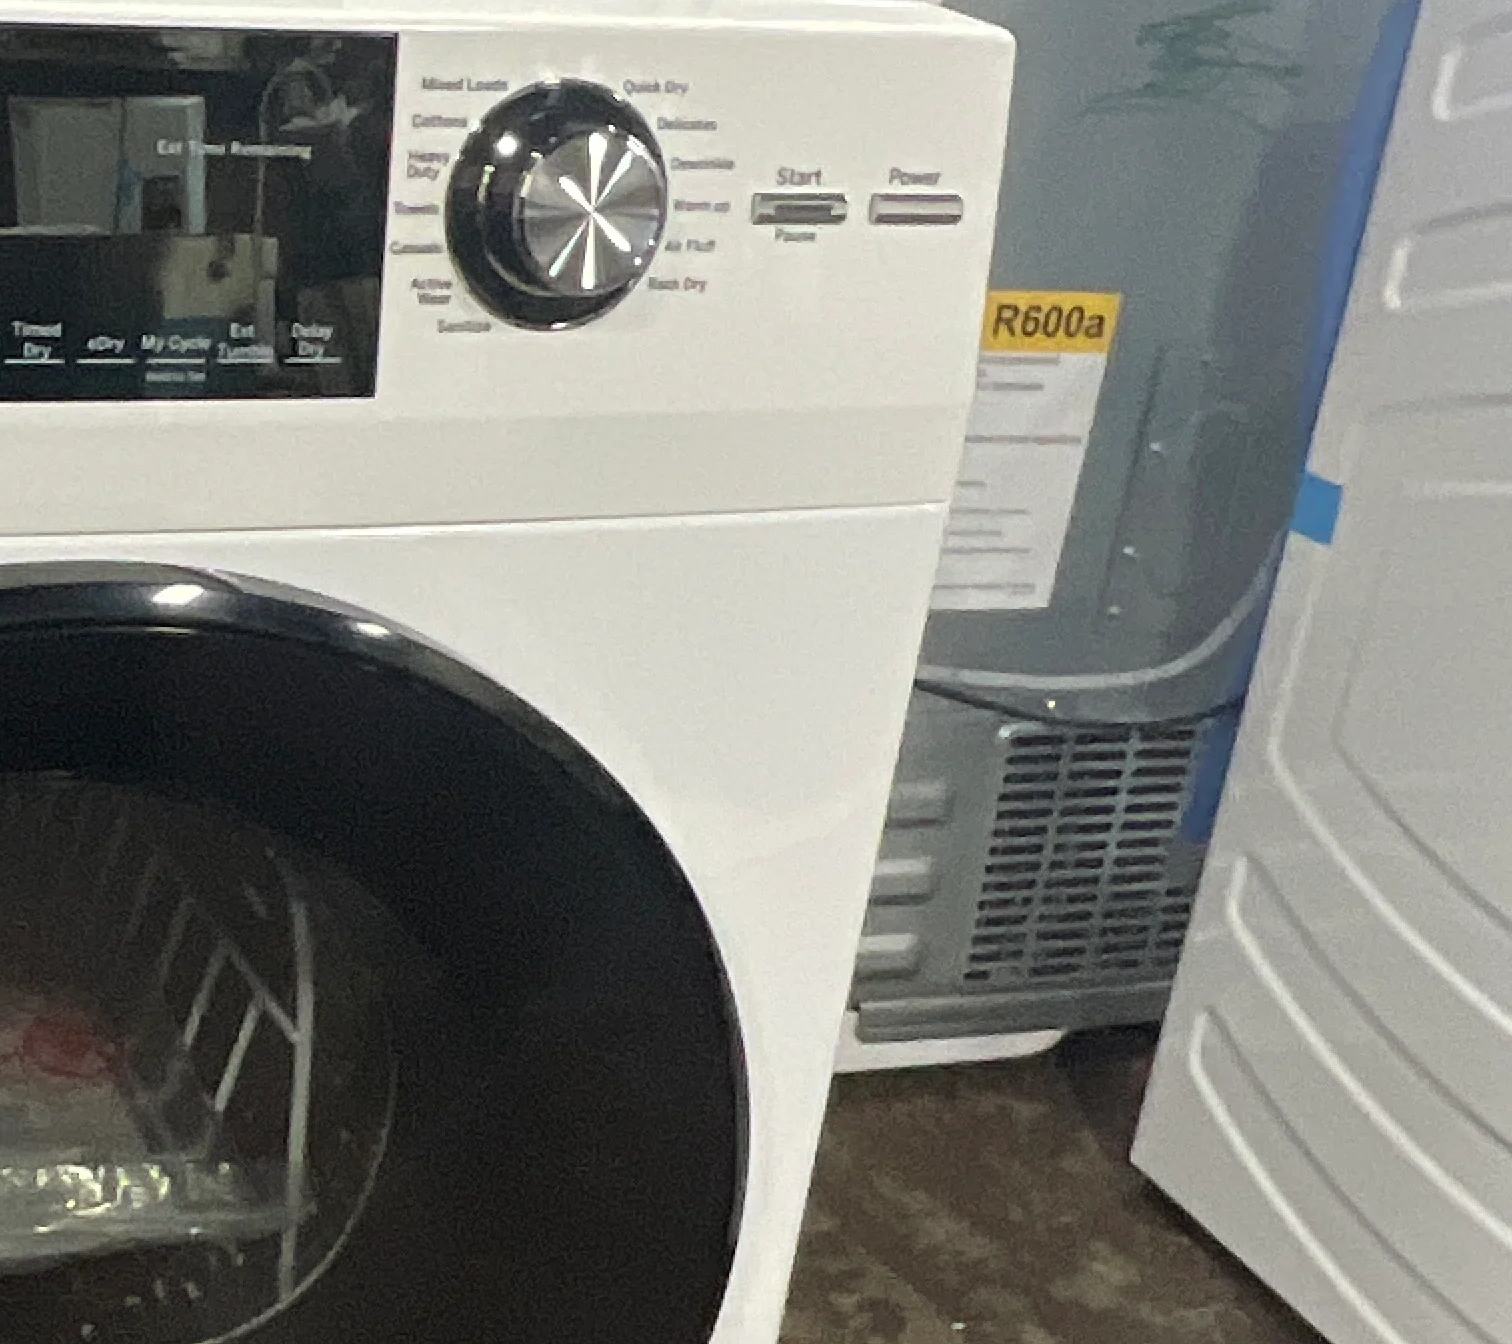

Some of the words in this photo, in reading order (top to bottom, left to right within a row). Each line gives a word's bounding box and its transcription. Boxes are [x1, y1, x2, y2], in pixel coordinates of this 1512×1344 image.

[623, 78, 659, 96] Quick
[665, 80, 688, 96] Dry
[776, 166, 822, 186] Start
[888, 167, 941, 186] Power
[684, 276, 707, 294] Dry
[11, 320, 62, 338] Timed
[992, 303, 1106, 339] R600a
[22, 342, 52, 362] Dry
[87, 335, 126, 354] eDry
[140, 334, 165, 354] My
[168, 334, 212, 354] Cycle
[298, 340, 326, 360] Dry
